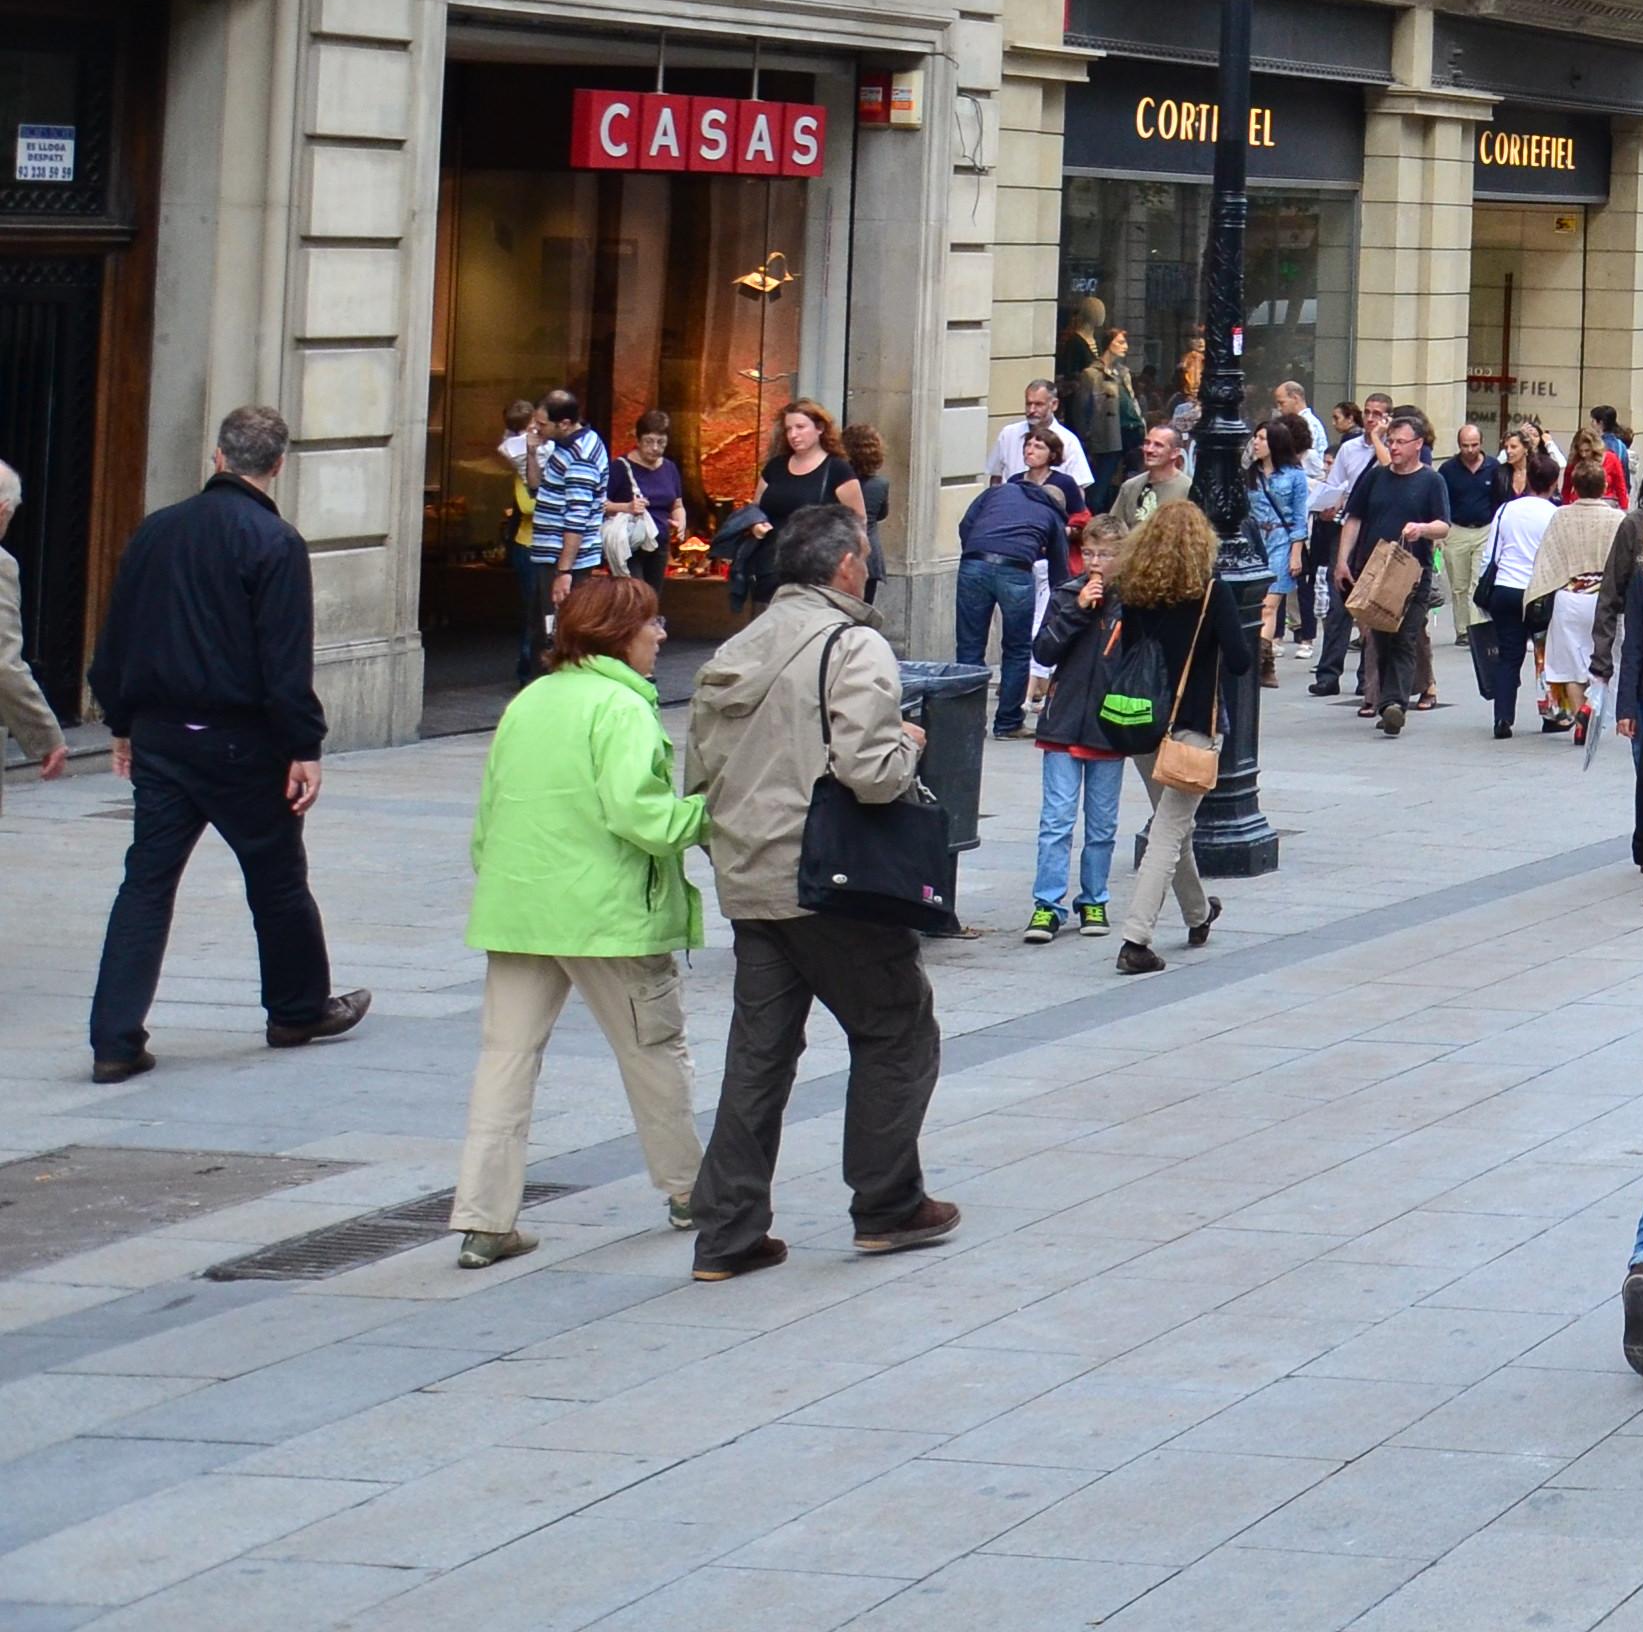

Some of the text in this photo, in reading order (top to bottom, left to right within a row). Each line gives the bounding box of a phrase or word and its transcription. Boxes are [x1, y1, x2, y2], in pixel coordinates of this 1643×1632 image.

[600, 103, 818, 165] CASAS
[1136, 96, 1276, 147] CORTEL
[1480, 130, 1576, 169] CORTEFIEL
[1466, 411, 1497, 422] OME
